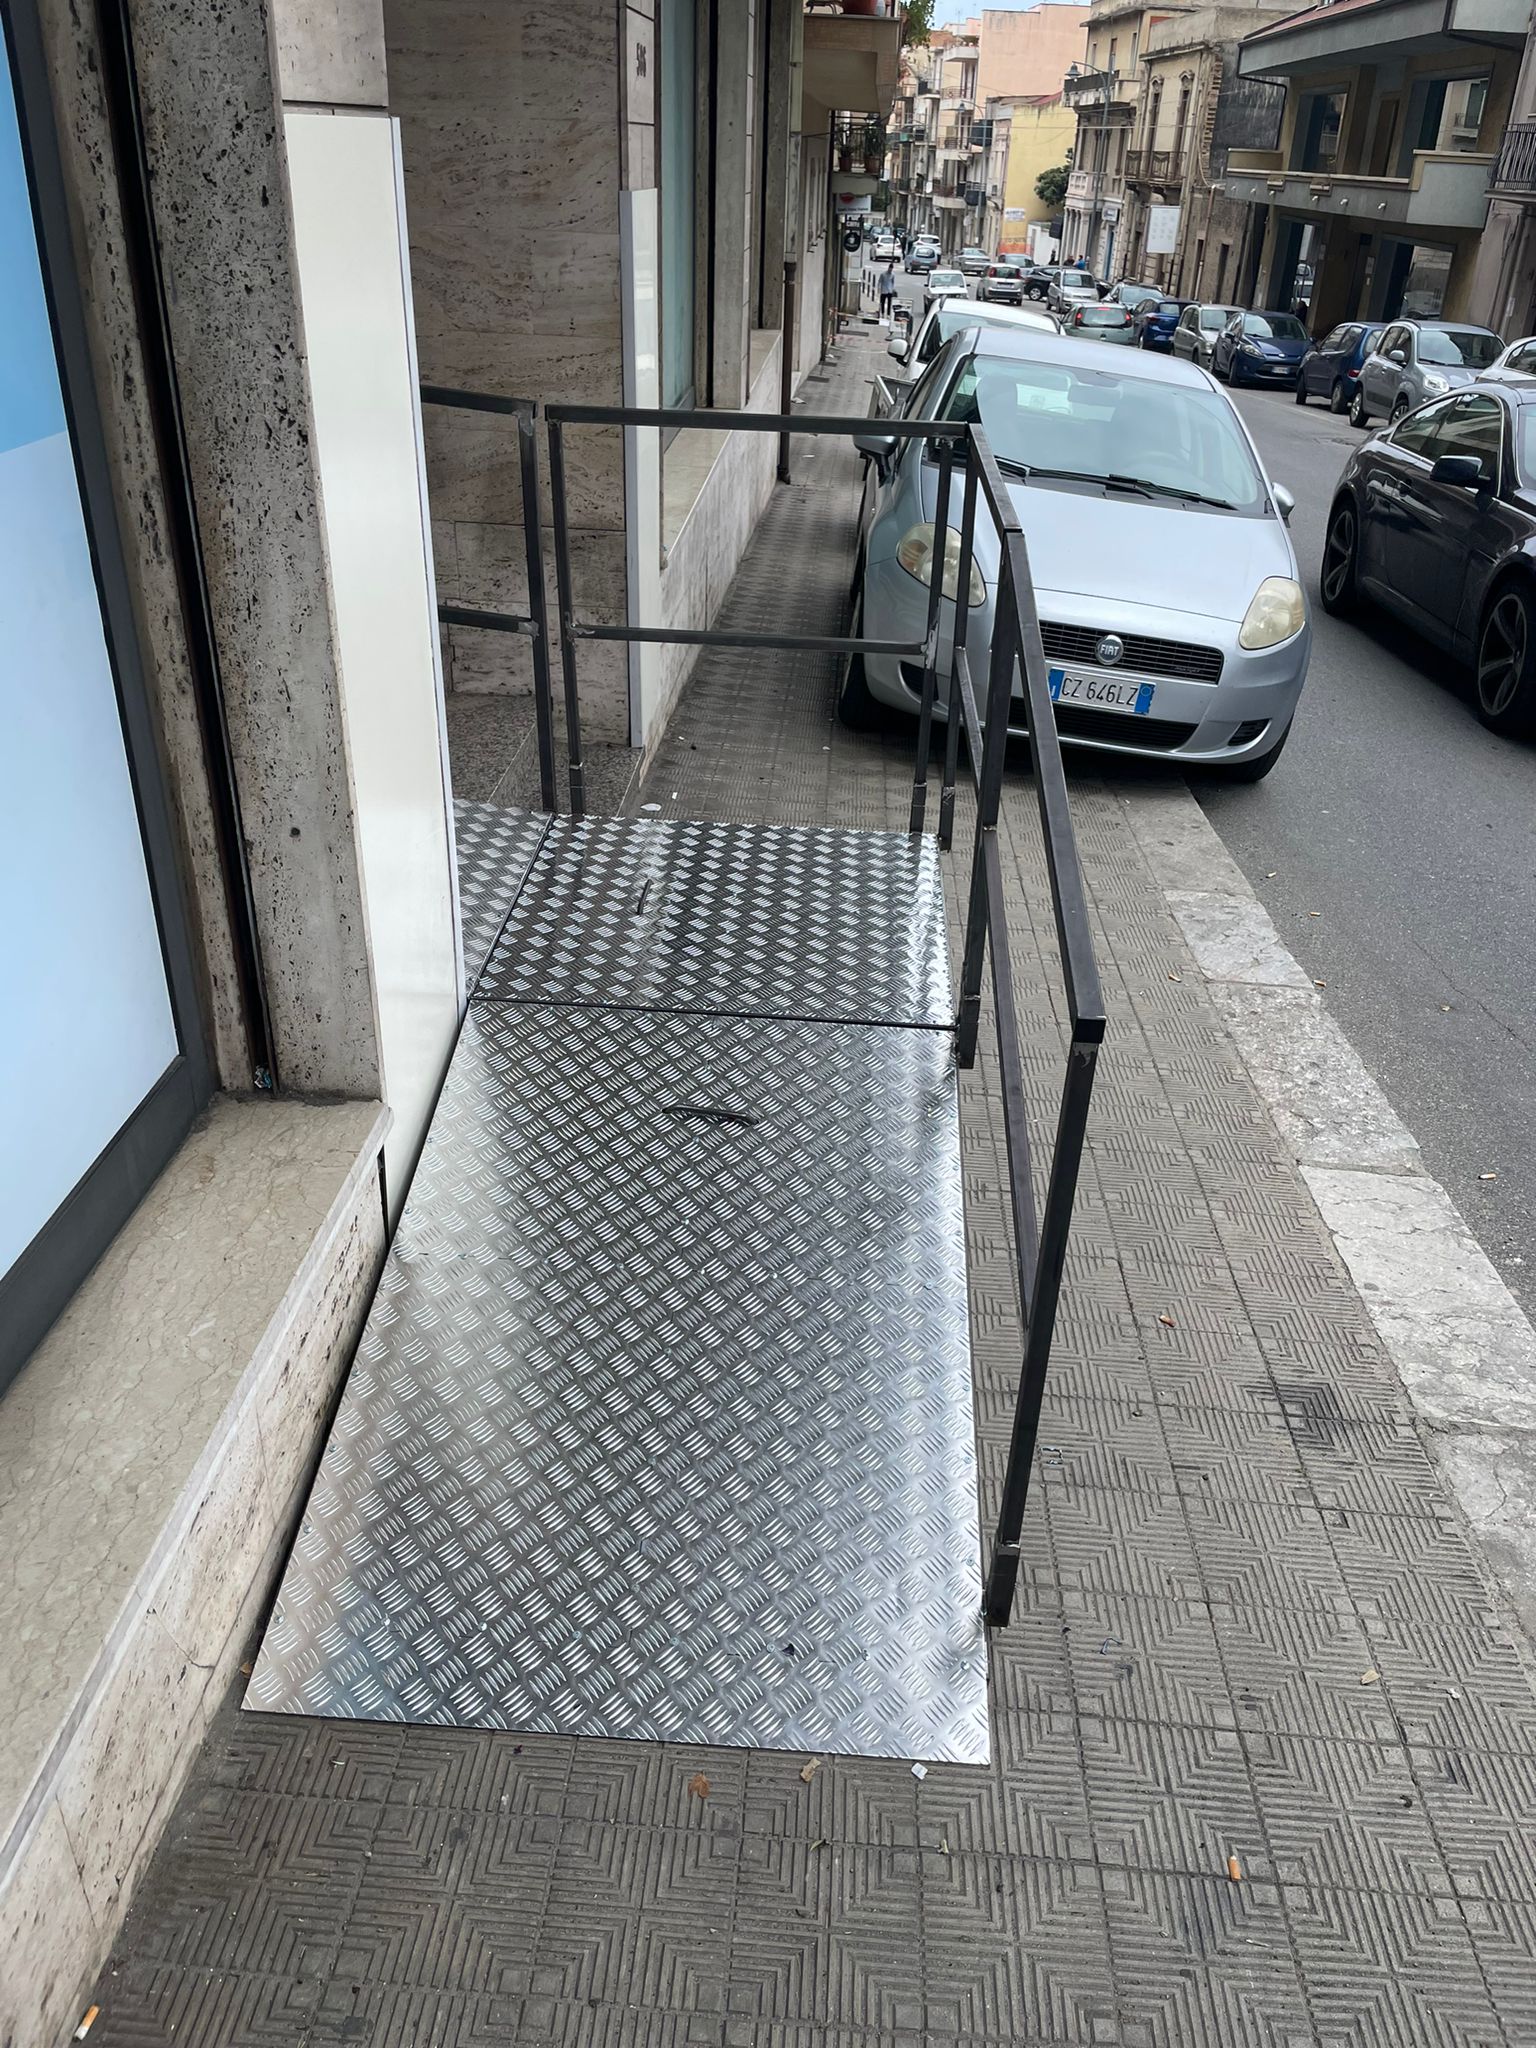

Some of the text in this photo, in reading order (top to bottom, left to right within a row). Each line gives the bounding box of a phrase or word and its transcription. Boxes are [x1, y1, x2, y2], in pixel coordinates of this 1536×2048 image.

[1100, 644, 1120, 656] FIAT
[1061, 677, 1138, 706] CZ 646LZ
